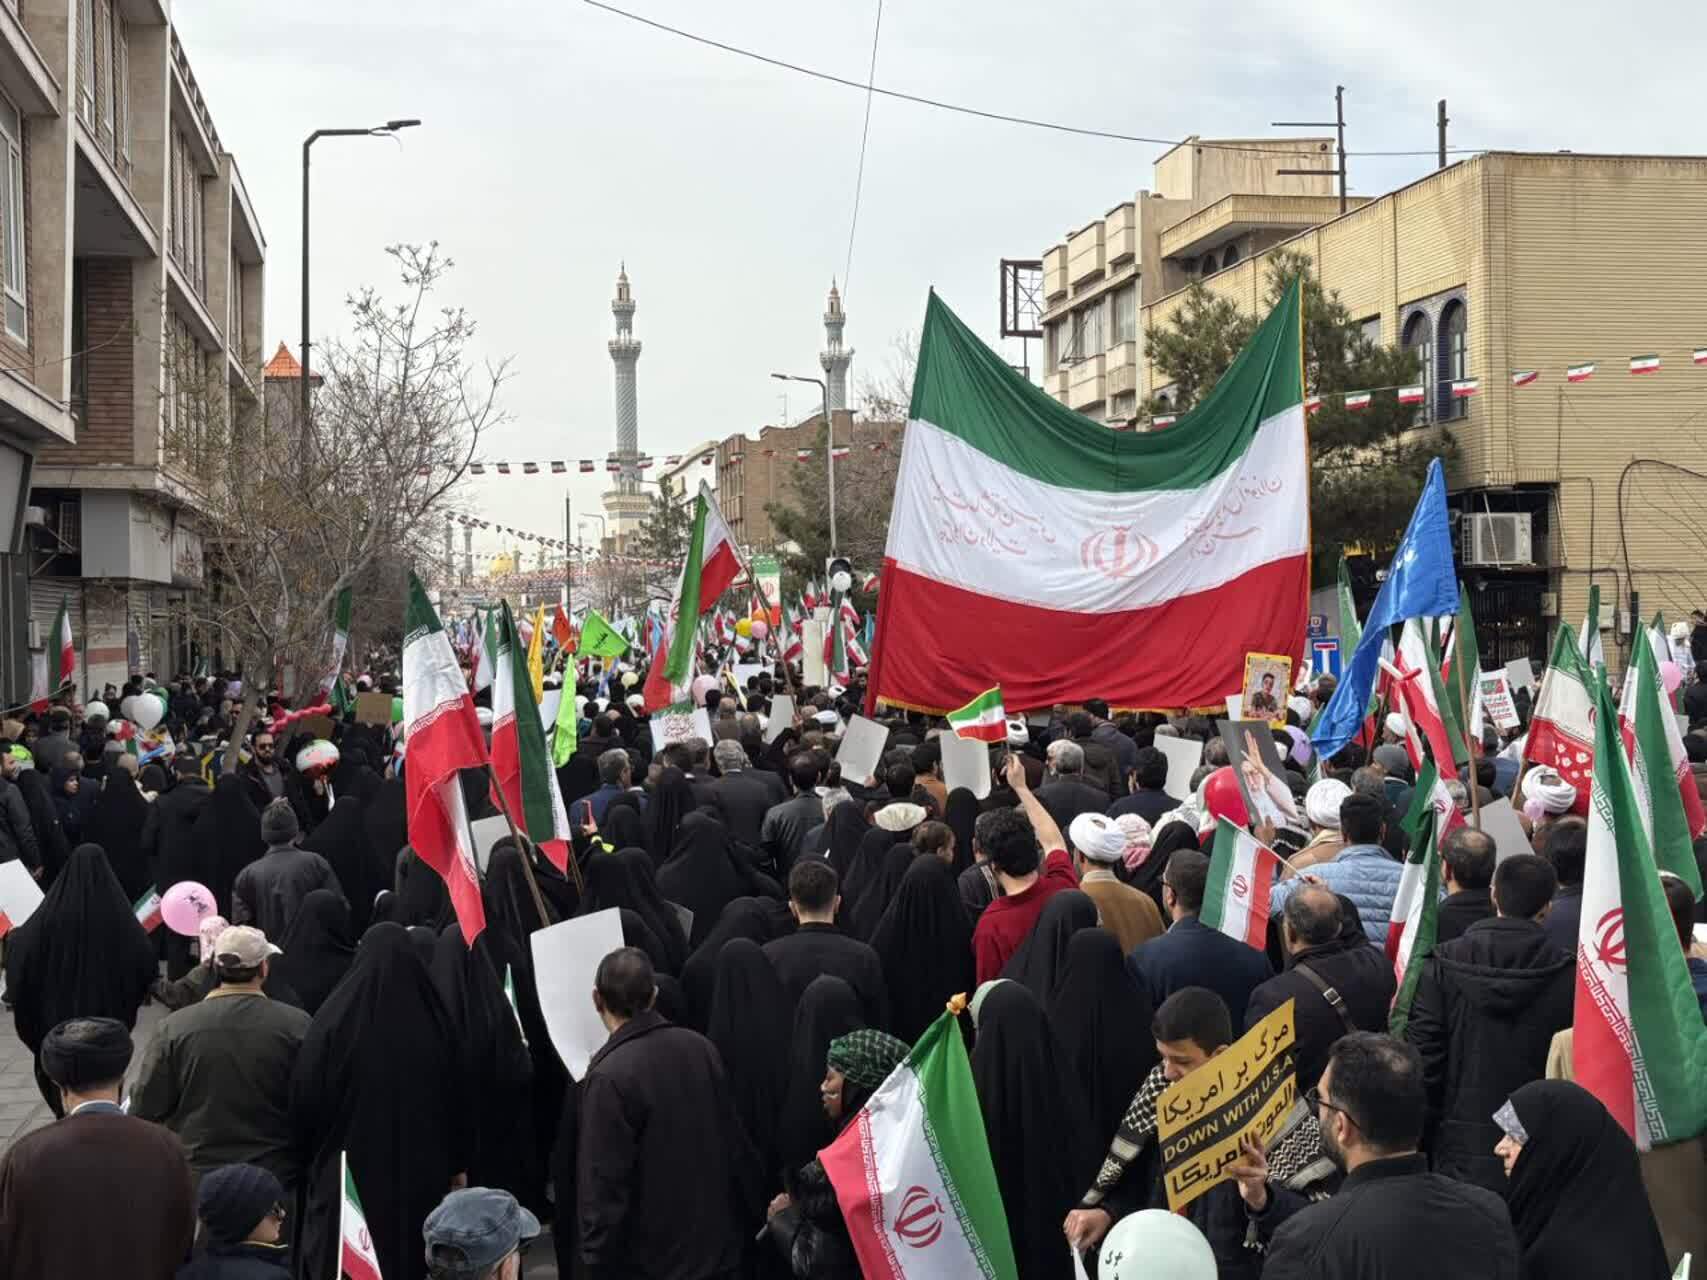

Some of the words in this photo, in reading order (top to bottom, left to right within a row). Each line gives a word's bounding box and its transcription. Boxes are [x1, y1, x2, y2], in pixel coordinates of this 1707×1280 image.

[1254, 1024, 1288, 1062] مرگ
[1233, 1061, 1249, 1090] بر
[1163, 1120, 1219, 1163] DOWN
[1223, 1087, 1260, 1126] WITH
